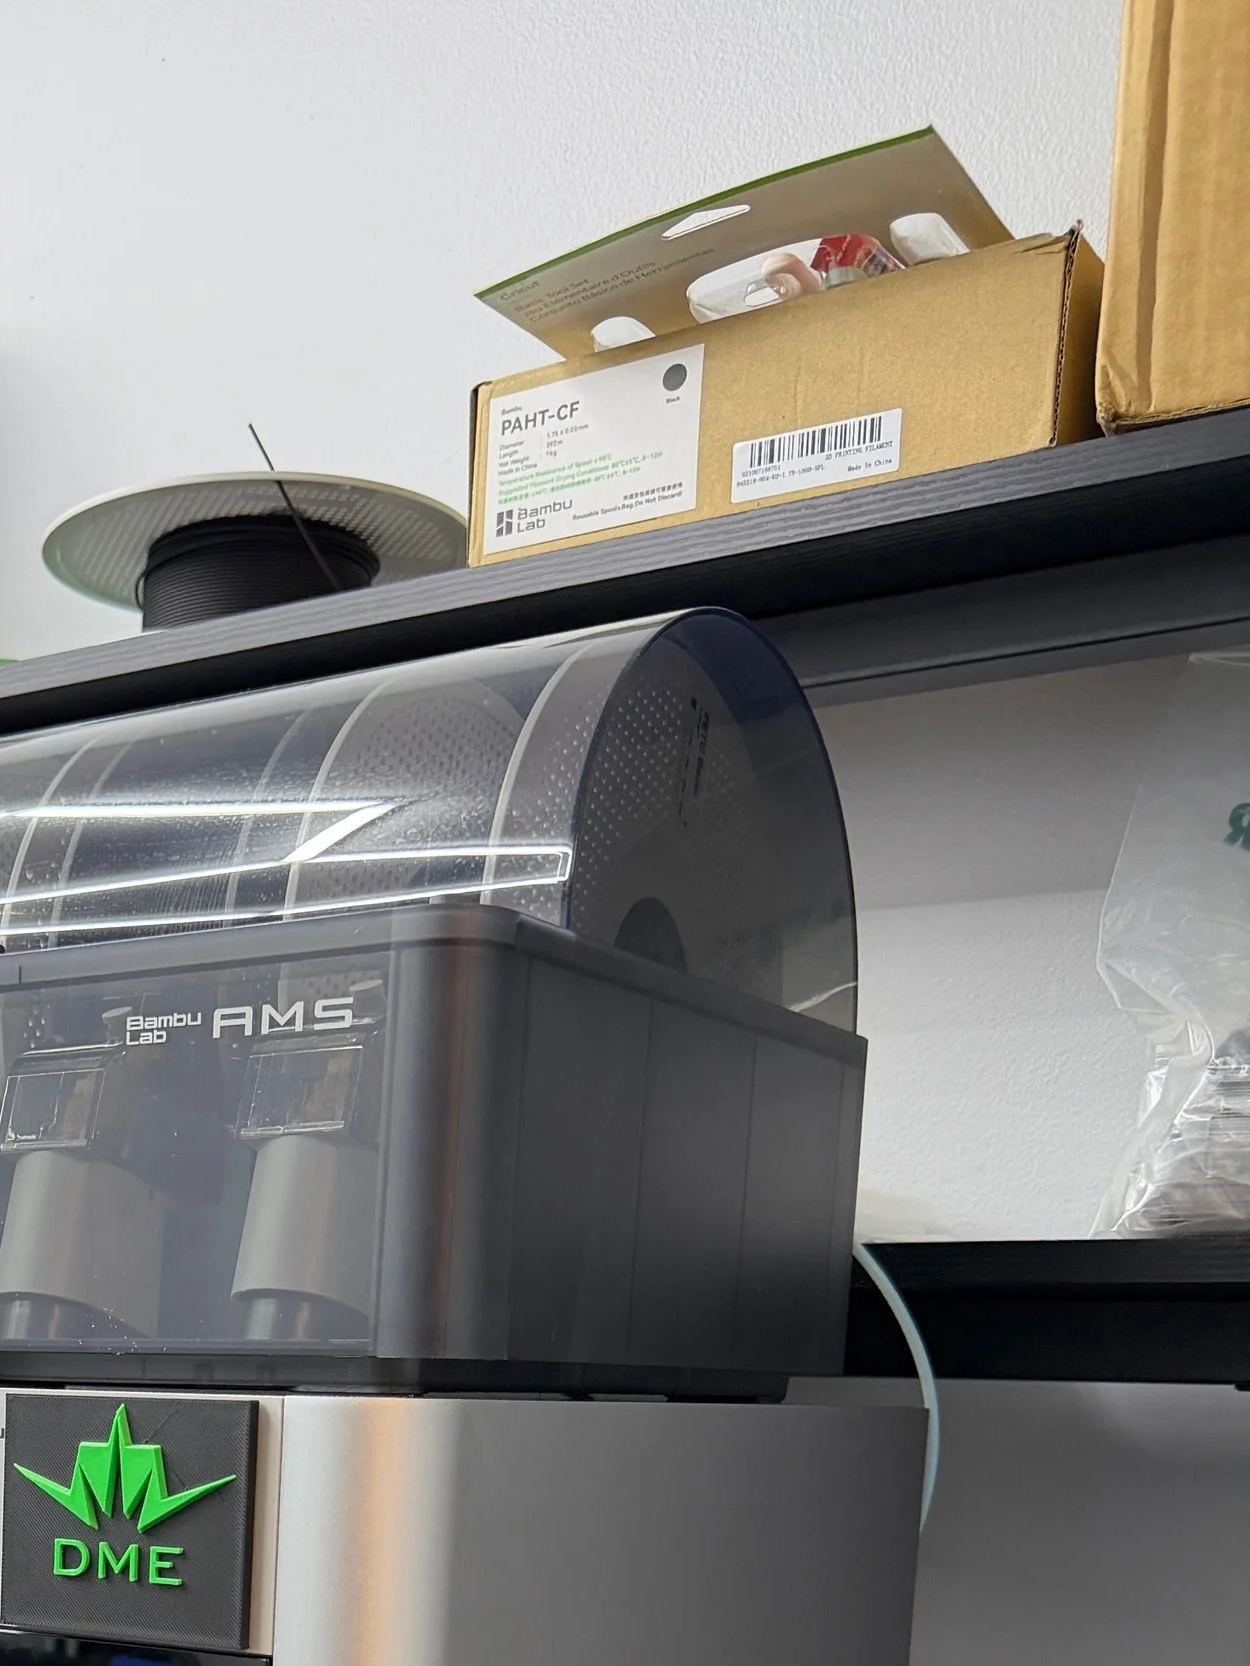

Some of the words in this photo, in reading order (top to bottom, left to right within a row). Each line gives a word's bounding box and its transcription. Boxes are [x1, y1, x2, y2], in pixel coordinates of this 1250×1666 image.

[501, 280, 541, 301] Cricut
[500, 401, 581, 436] PAHT-CF
[835, 448, 863, 459] PRINTING
[865, 440, 894, 453] FILAMENT
[517, 499, 573, 521] Bambu
[517, 517, 546, 533] Lab
[126, 1012, 201, 1031] Bambu
[212, 996, 354, 1039] AMS
[126, 1029, 167, 1046] Lab
[53, 1537, 184, 1586] DME
